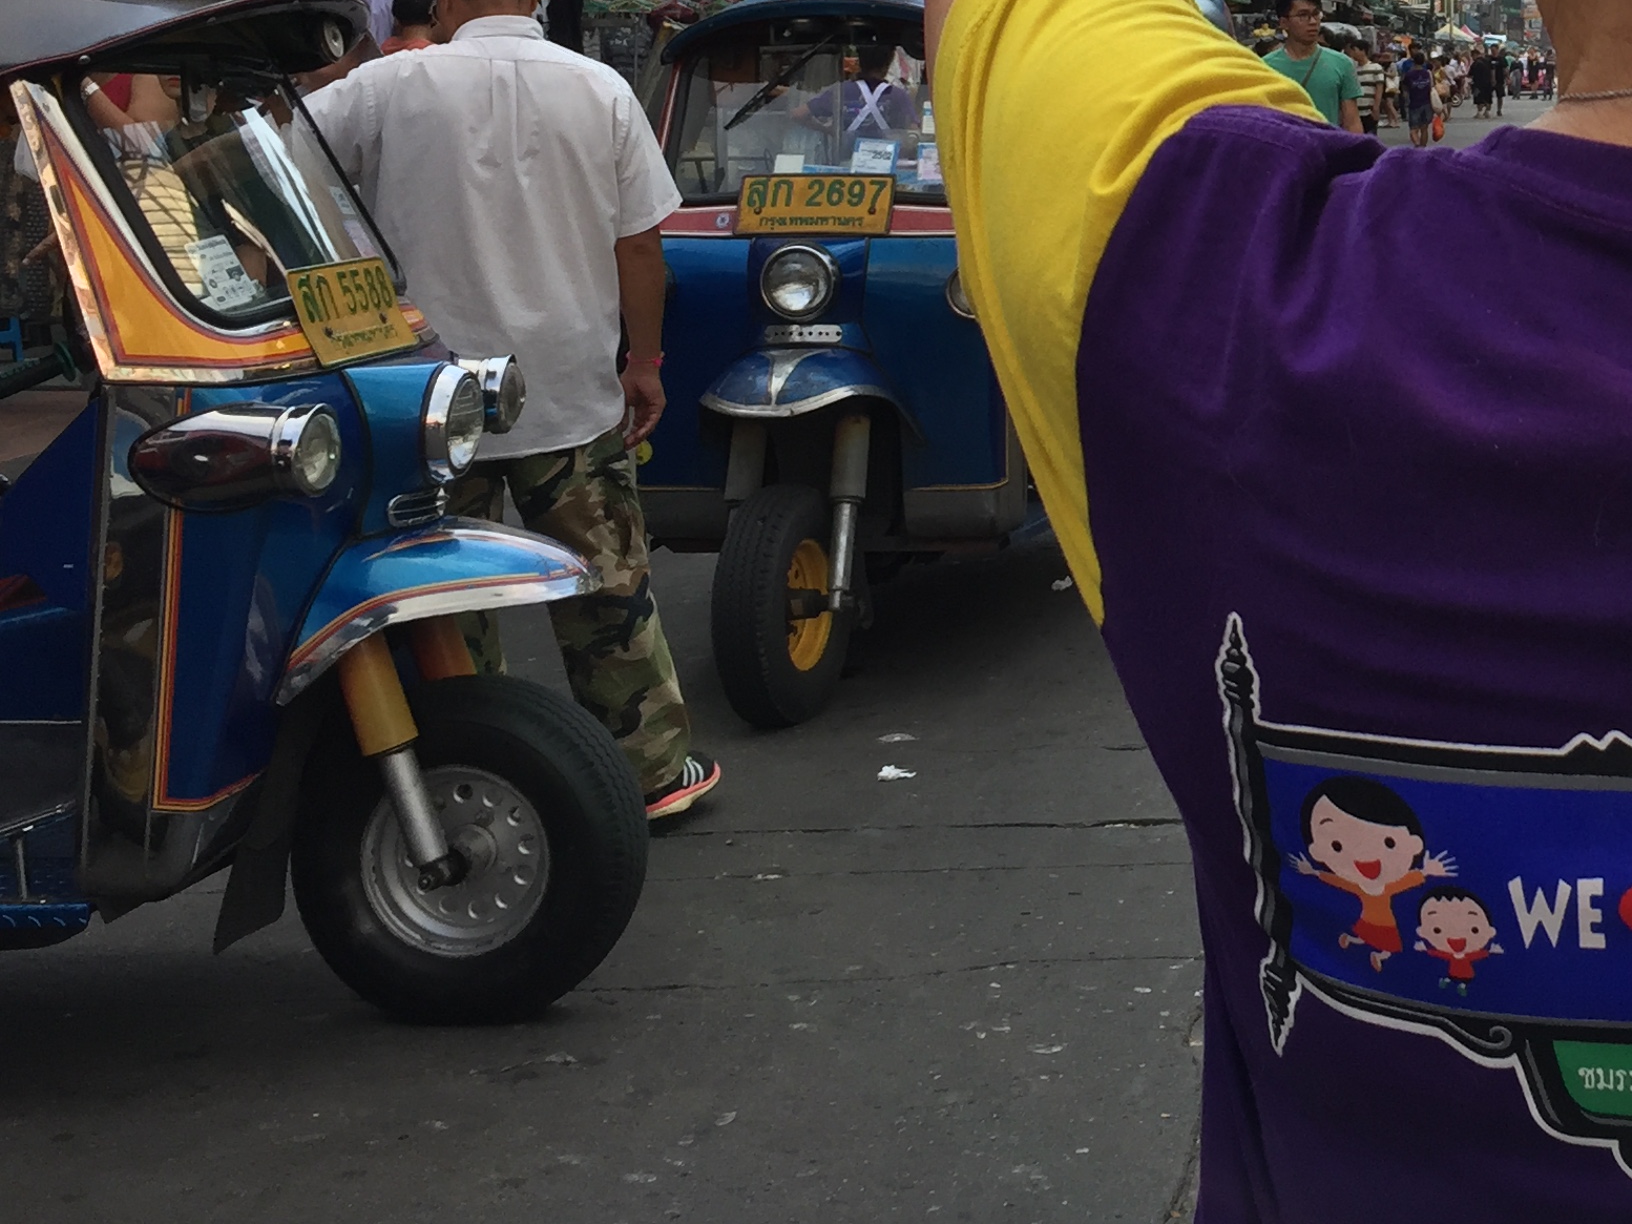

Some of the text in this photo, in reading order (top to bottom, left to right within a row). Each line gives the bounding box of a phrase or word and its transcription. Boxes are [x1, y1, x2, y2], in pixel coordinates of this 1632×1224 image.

[805, 179, 888, 209] 2697
[336, 265, 394, 315] 5588
[1508, 876, 1607, 951] WE
